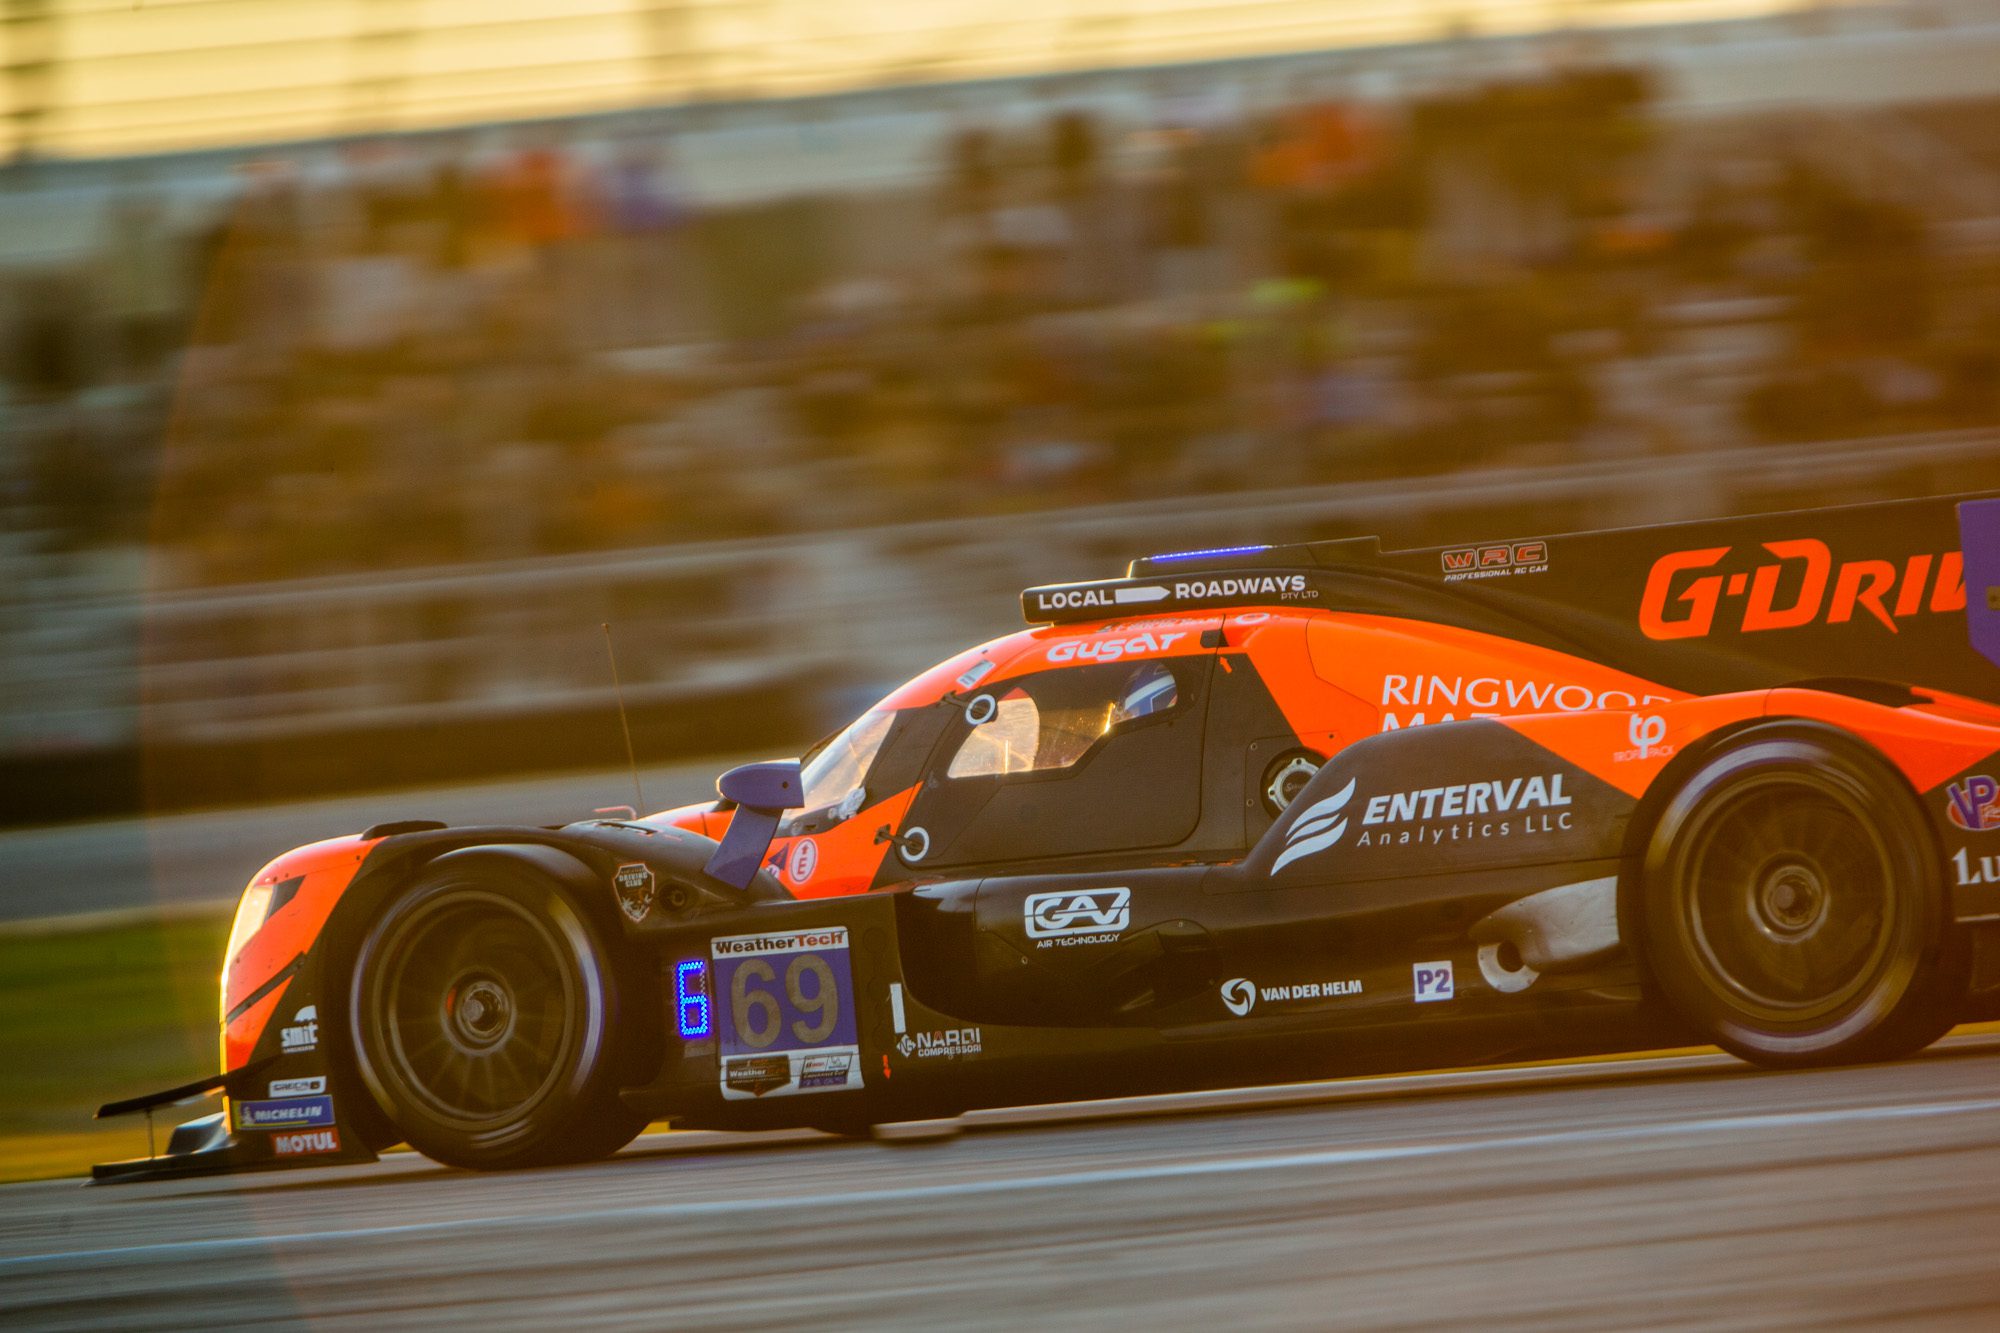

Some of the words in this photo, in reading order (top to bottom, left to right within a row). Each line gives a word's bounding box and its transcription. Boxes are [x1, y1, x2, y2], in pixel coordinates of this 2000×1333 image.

[1443, 544, 1544, 569] WRC
[1444, 569, 1511, 582] PROFESSIONAL
[1514, 567, 1527, 575] RC
[1529, 564, 1549, 573] CAR
[1039, 589, 1114, 610] LOCAL
[1175, 575, 1306, 600] ROADWAYS
[1281, 592, 1299, 600] PTY
[1301, 590, 1319, 599] LTD
[1362, 773, 1572, 825] ENTERVAL
[1356, 821, 1510, 847] Analytics
[1525, 812, 1573, 833] LLC
[797, 857, 807, 875] E
[625, 879, 642, 887] CLUB
[715, 932, 844, 954] WeatherTech
[1036, 940, 1053, 950] AIR
[1055, 933, 1120, 947] TECHNOLOGY
[1261, 986, 1290, 1001] VAN
[1292, 984, 1321, 999] DER
[1322, 980, 1363, 996] HELM
[1416, 968, 1451, 995] P2
[677, 960, 709, 1037] 6
[730, 953, 839, 1049] 69
[917, 1027, 981, 1048] NARDI
[918, 1044, 982, 1057] COMPRESSORI
[255, 1105, 323, 1121] MICHELIN
[275, 1131, 337, 1153] MOTUL
